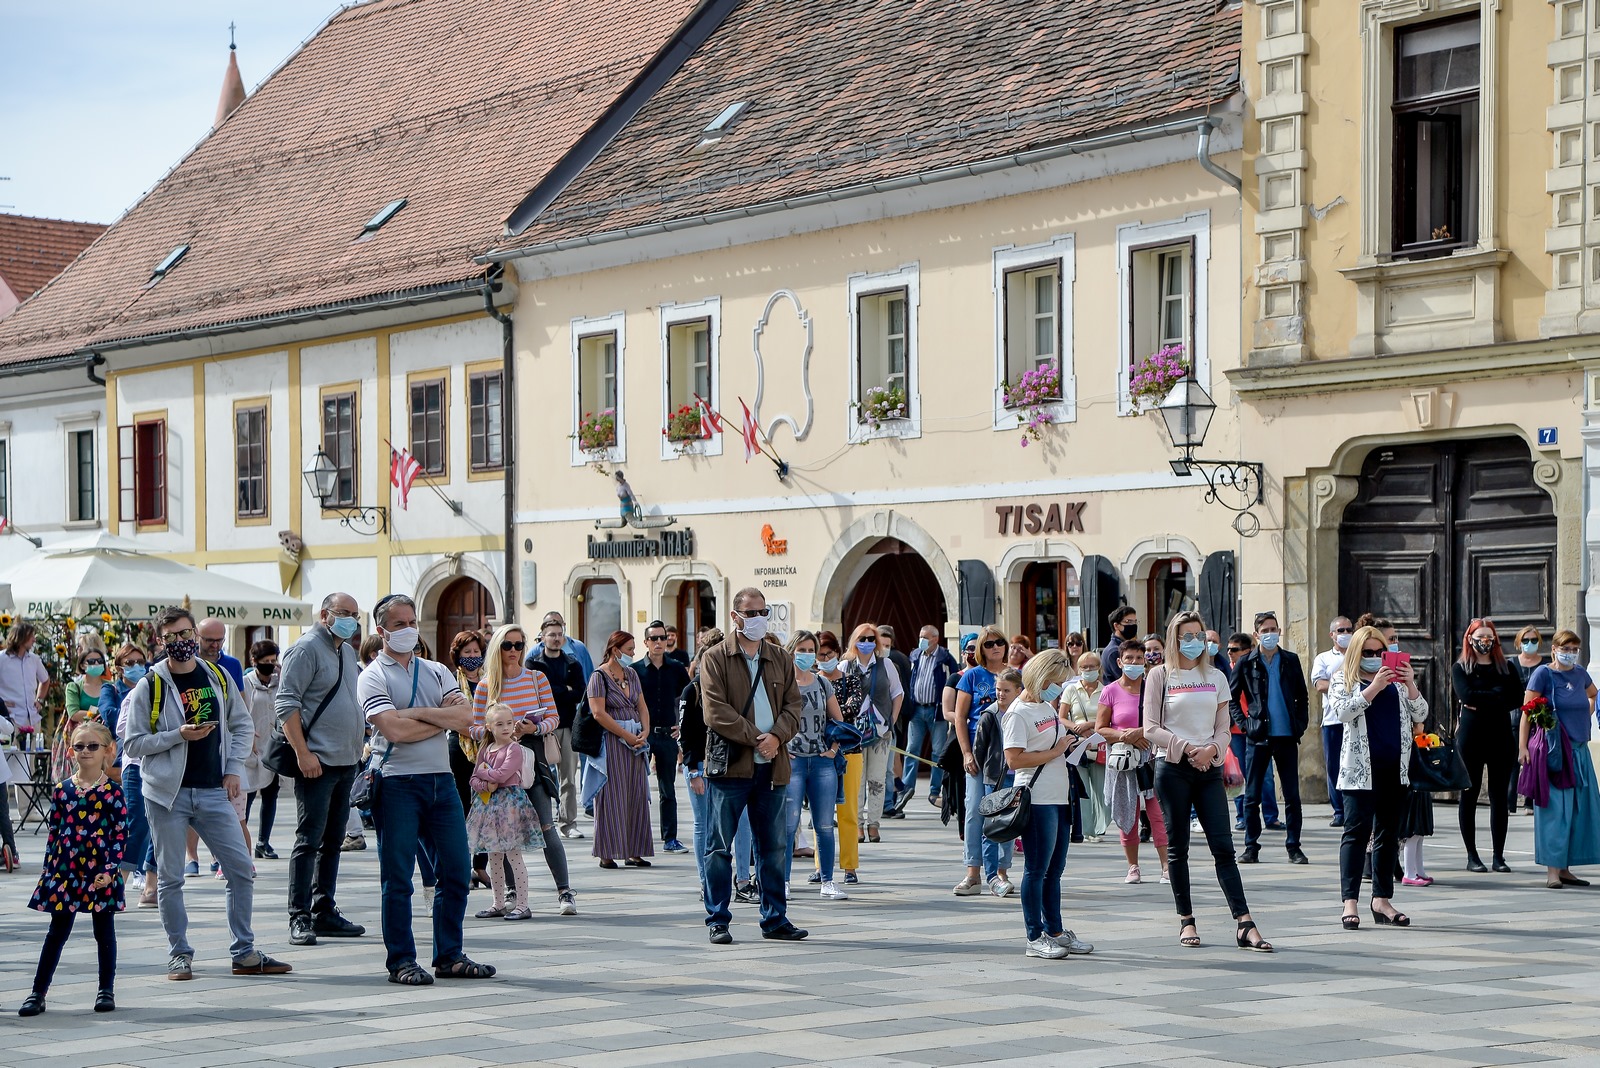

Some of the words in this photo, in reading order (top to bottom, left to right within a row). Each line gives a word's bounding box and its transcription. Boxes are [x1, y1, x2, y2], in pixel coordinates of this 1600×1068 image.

[1543, 430, 1551, 443] 7
[996, 502, 1086, 534] TISAK
[660, 527, 692, 556] KRAŠ
[754, 565, 797, 576] INFORMATIČKA
[763, 580, 787, 588] OPREMA
[28, 602, 52, 614] PAN
[88, 603, 120, 615] PAN
[206, 606, 236, 618] PAN
[263, 607, 292, 620] PAN
[766, 604, 787, 621] OTO
